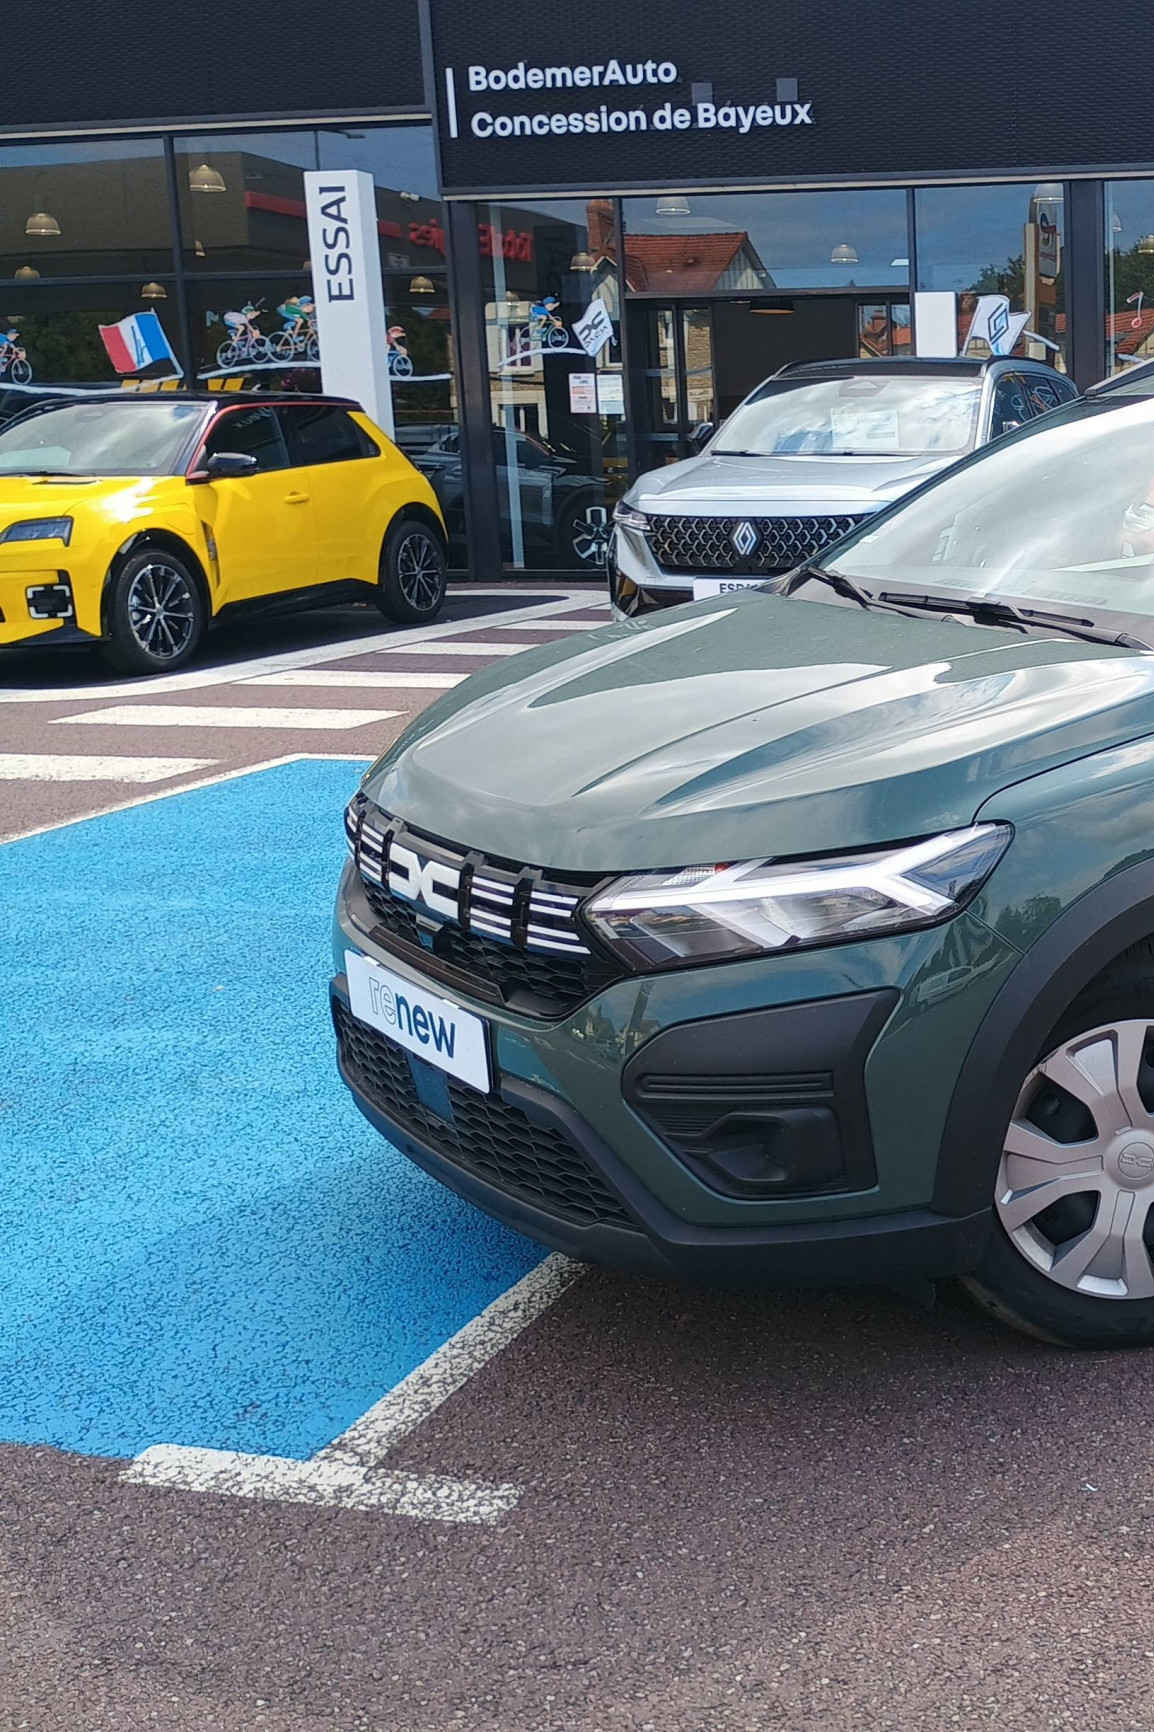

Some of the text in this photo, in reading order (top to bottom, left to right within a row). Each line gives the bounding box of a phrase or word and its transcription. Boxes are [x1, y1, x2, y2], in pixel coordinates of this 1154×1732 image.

[468, 59, 678, 91] BodemerAuto
[470, 101, 814, 138] Concession de Bayeux
[318, 185, 355, 303] ESSAI
[368, 976, 456, 1059] renew
